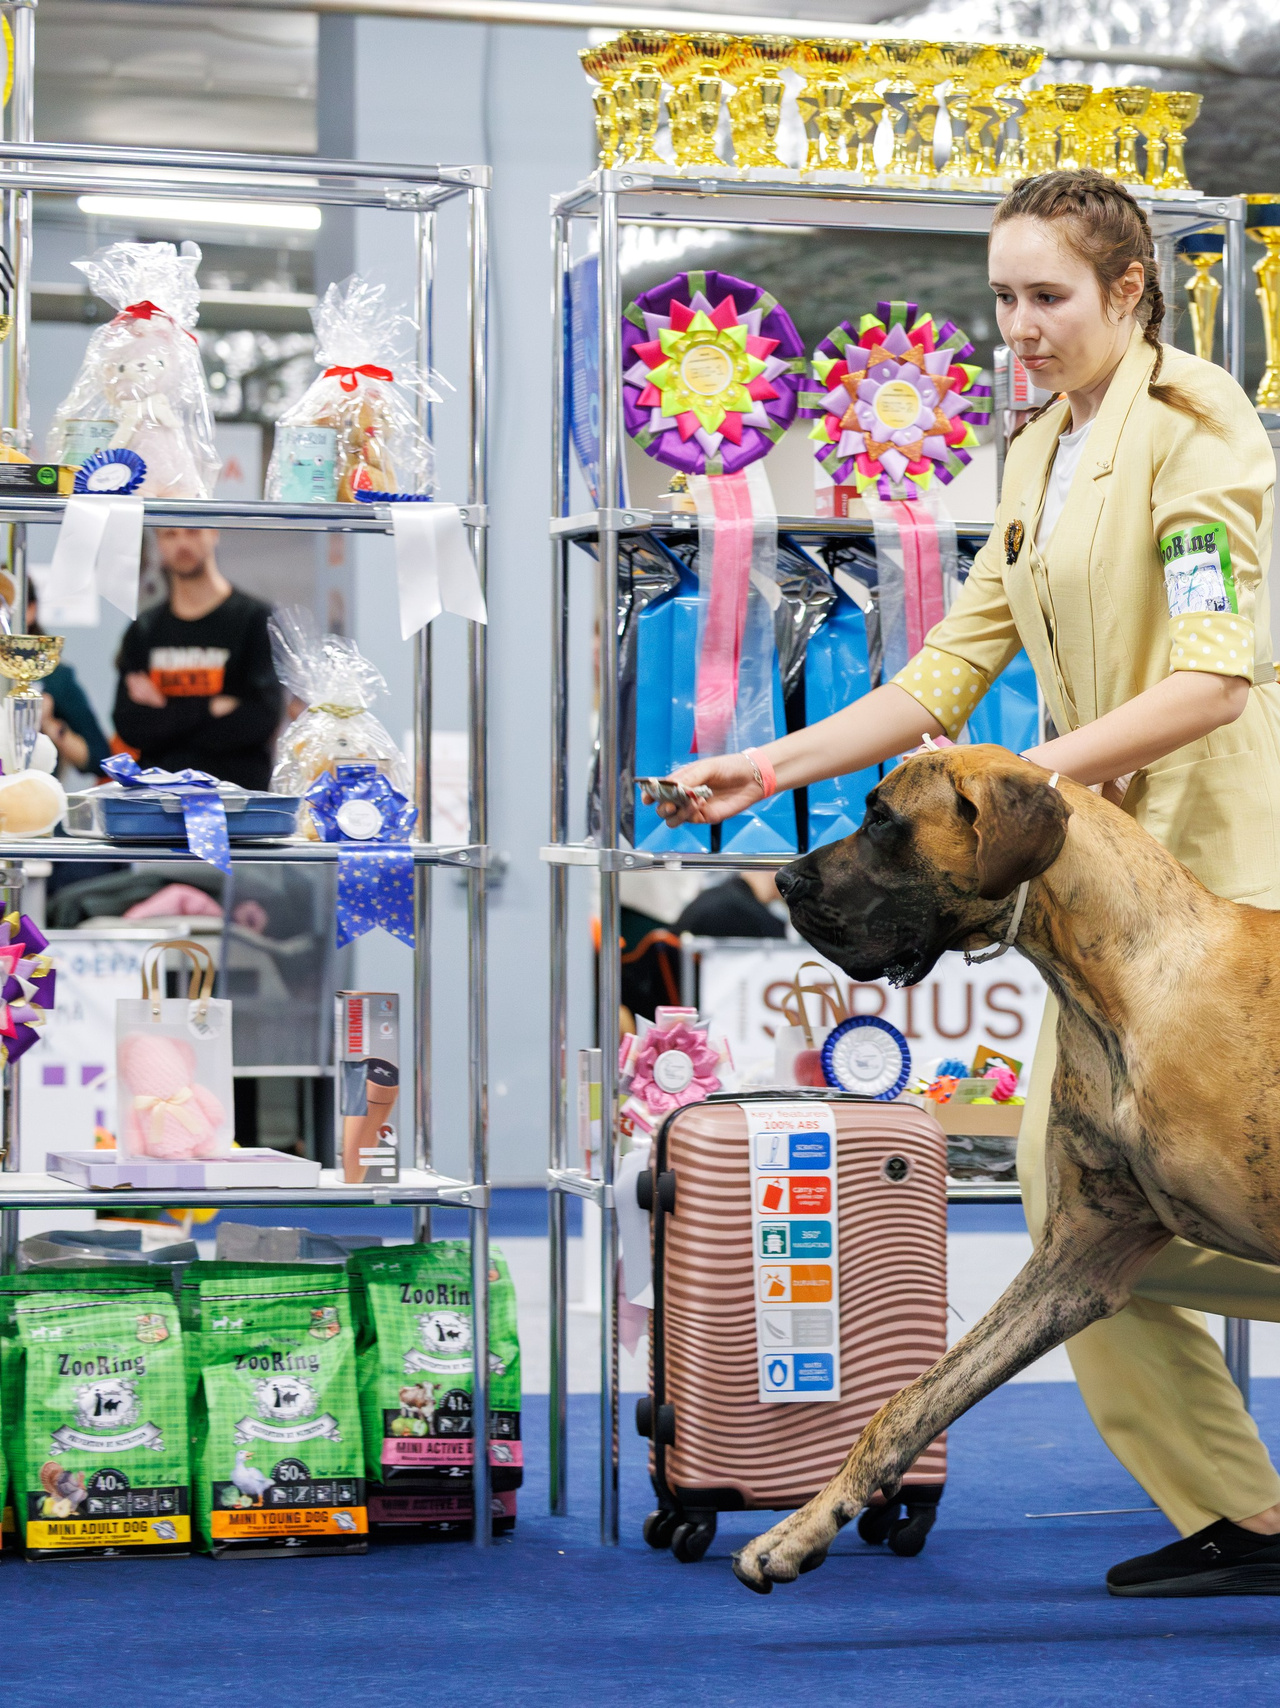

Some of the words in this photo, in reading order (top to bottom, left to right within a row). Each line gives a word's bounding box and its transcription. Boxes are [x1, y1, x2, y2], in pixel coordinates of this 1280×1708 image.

[764, 1120, 795, 1130] 100%
[797, 1120, 820, 1130] ABS
[400, 1283, 471, 1306] ZooRin
[58, 1352, 147, 1377] ZooRing
[233, 1351, 320, 1373] ZooRing
[396, 1441, 423, 1454] MINI
[426, 1442, 464, 1454] ACTIVE
[228, 1513, 257, 1525] MINI
[262, 1511, 301, 1524] YOUNG
[305, 1510, 329, 1523] DOG
[47, 1523, 76, 1535] MINI
[80, 1521, 119, 1534] ADULT
[123, 1520, 148, 1533] DOG
